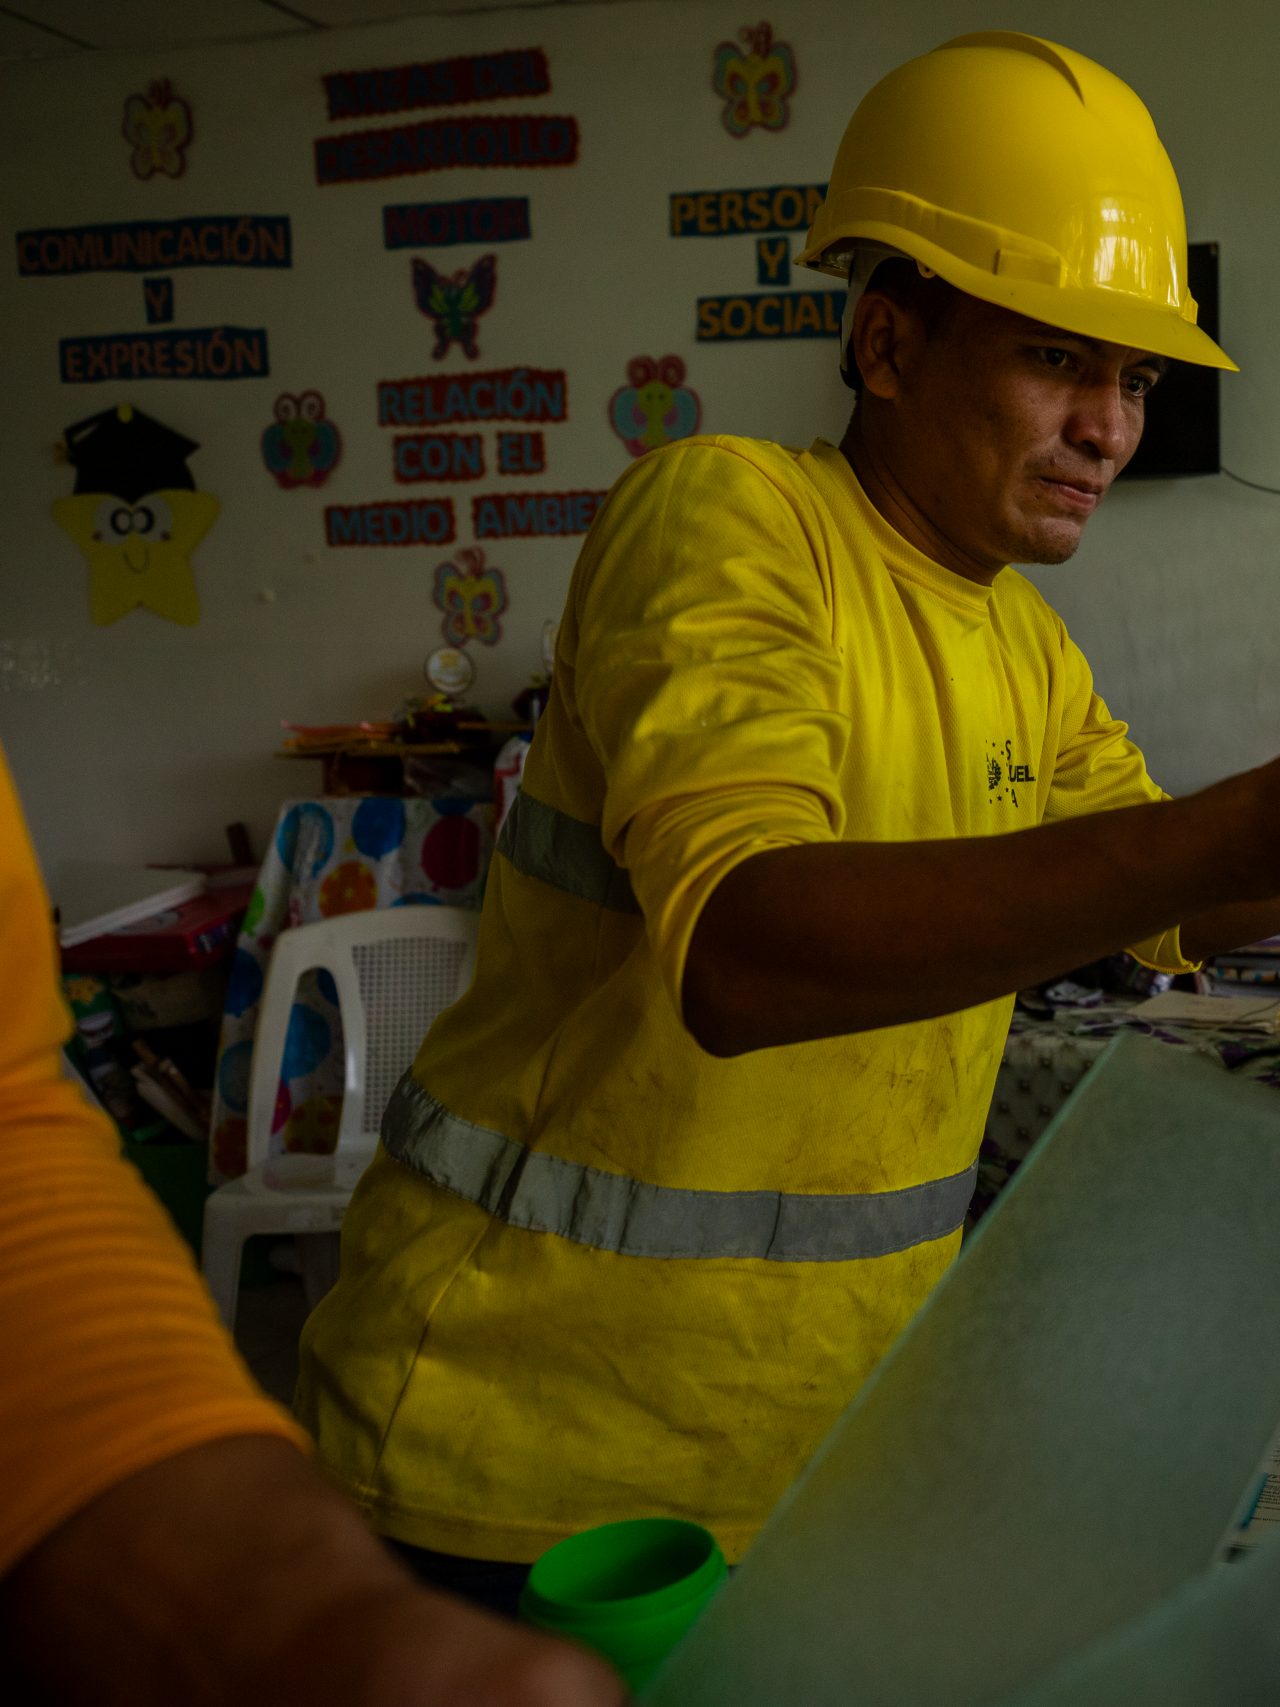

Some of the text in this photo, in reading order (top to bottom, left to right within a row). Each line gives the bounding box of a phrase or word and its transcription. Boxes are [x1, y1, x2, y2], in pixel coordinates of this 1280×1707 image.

[473, 52, 545, 97] DEL
[318, 119, 570, 181] DESARROLLO
[18, 216, 286, 271] COMUNICACIÓN
[385, 200, 529, 245] MOTOR
[758, 240, 785, 279] Y
[145, 282, 169, 321] Y
[698, 294, 840, 338] SOCIAL
[64, 328, 263, 381] EXPRESIÓN
[379, 369, 562, 425] RELACIÓN
[397, 434, 542, 477] CON EL
[329, 495, 608, 545] MEDIO AMBIE
